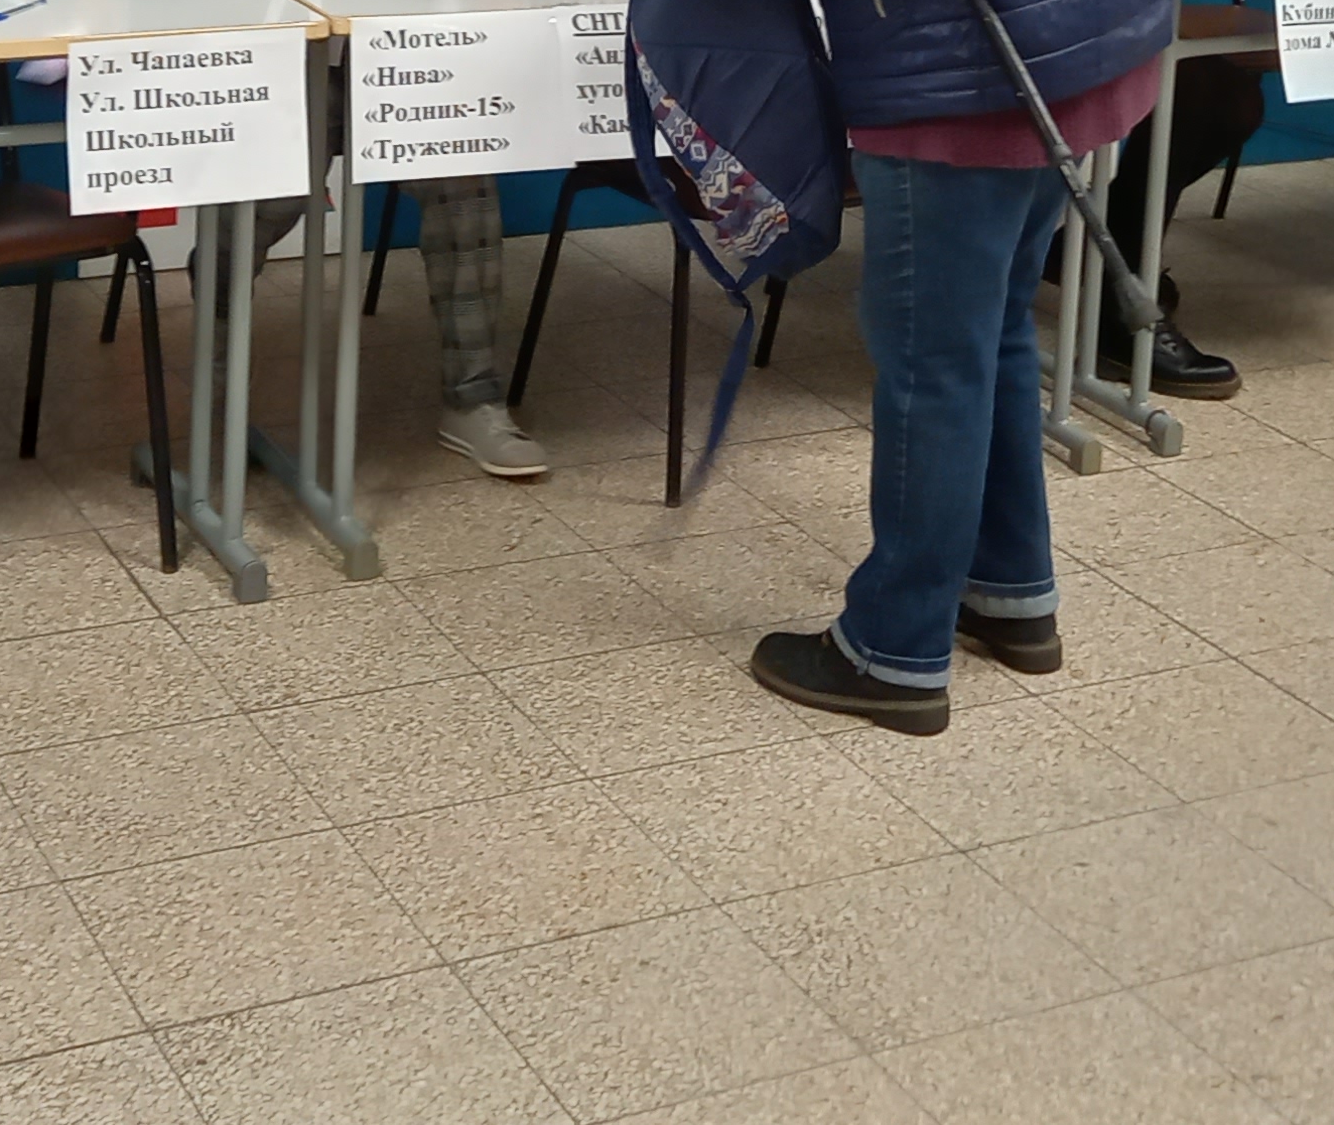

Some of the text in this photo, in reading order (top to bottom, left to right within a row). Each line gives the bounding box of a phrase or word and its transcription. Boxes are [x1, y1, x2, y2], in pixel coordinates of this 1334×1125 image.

[571, 12, 625, 33] СНТ
[369, 29, 488, 51] «Мотель»
[78, 49, 254, 76] Ул. Чапаевка
[362, 66, 455, 88] «Нива»
[79, 85, 270, 114] Ул. Школьная
[364, 96, 516, 124] «Родник-15»
[85, 121, 236, 152] Школьный
[360, 136, 511, 163] «Труженик»
[87, 167, 174, 193] проезд
